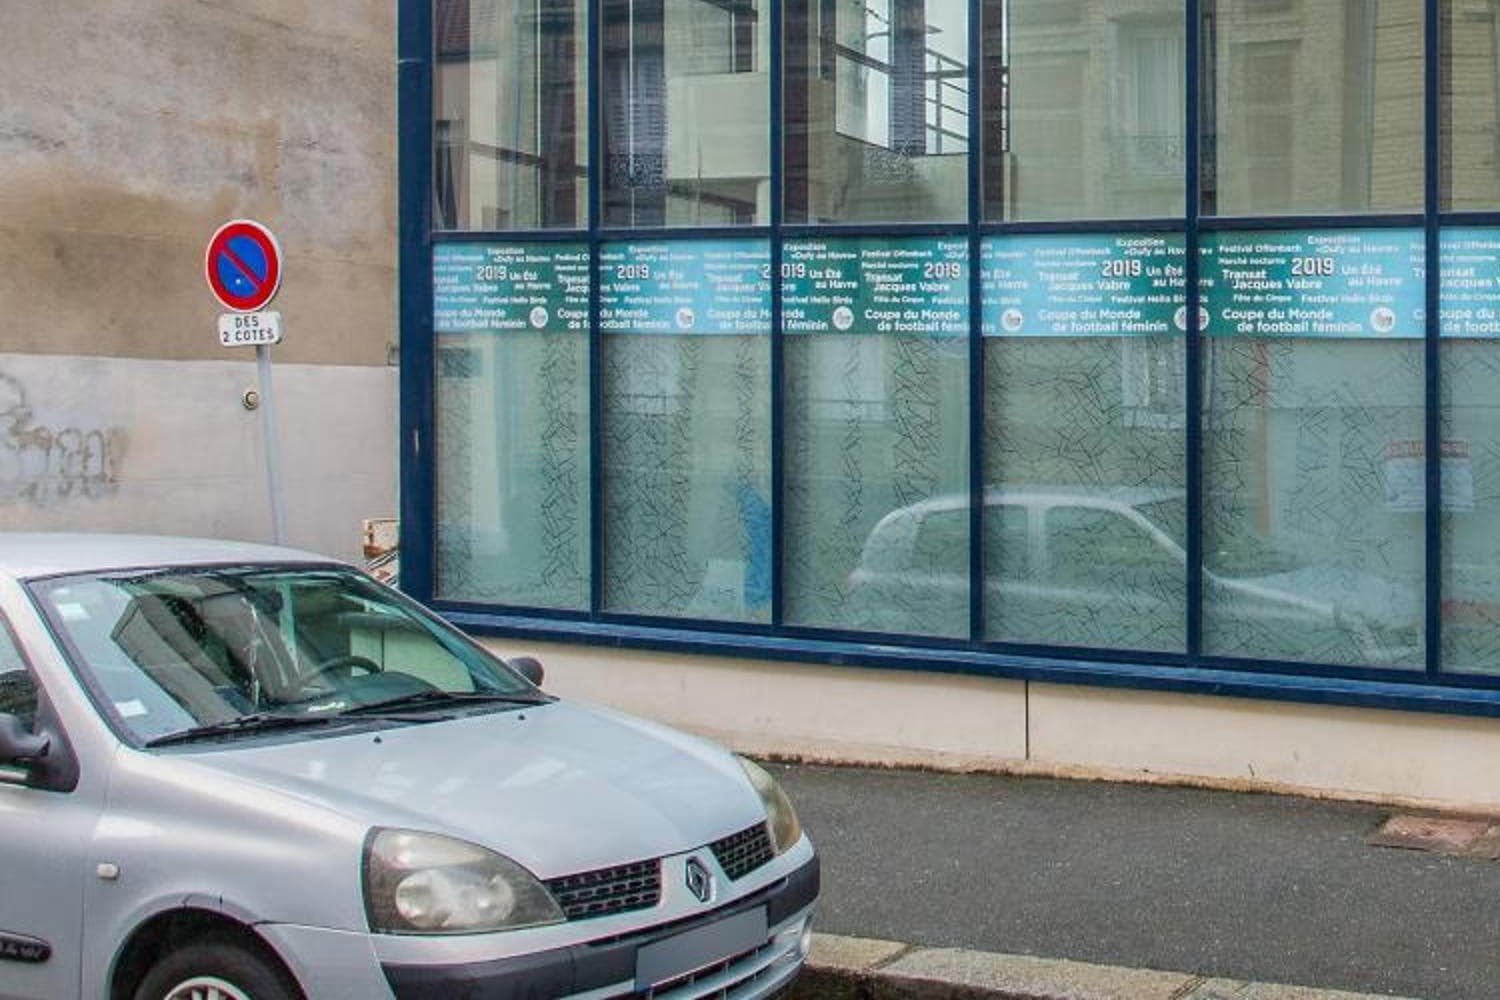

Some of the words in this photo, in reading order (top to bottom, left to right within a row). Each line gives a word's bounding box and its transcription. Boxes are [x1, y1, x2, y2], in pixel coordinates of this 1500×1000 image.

[476, 265, 506, 280] 2019
[617, 264, 649, 279] 2019
[924, 261, 961, 279] 2019
[1102, 260, 1141, 277] 2019
[1291, 257, 1335, 275] 2019
[1232, 279, 1282, 290] Jacques
[1222, 308, 1264, 320] Coupe
[1267, 308, 1285, 320] du
[1289, 308, 1333, 320] Monde
[235, 316, 259, 329] DES
[1237, 321, 1254, 333] de
[223, 331, 230, 342] 2
